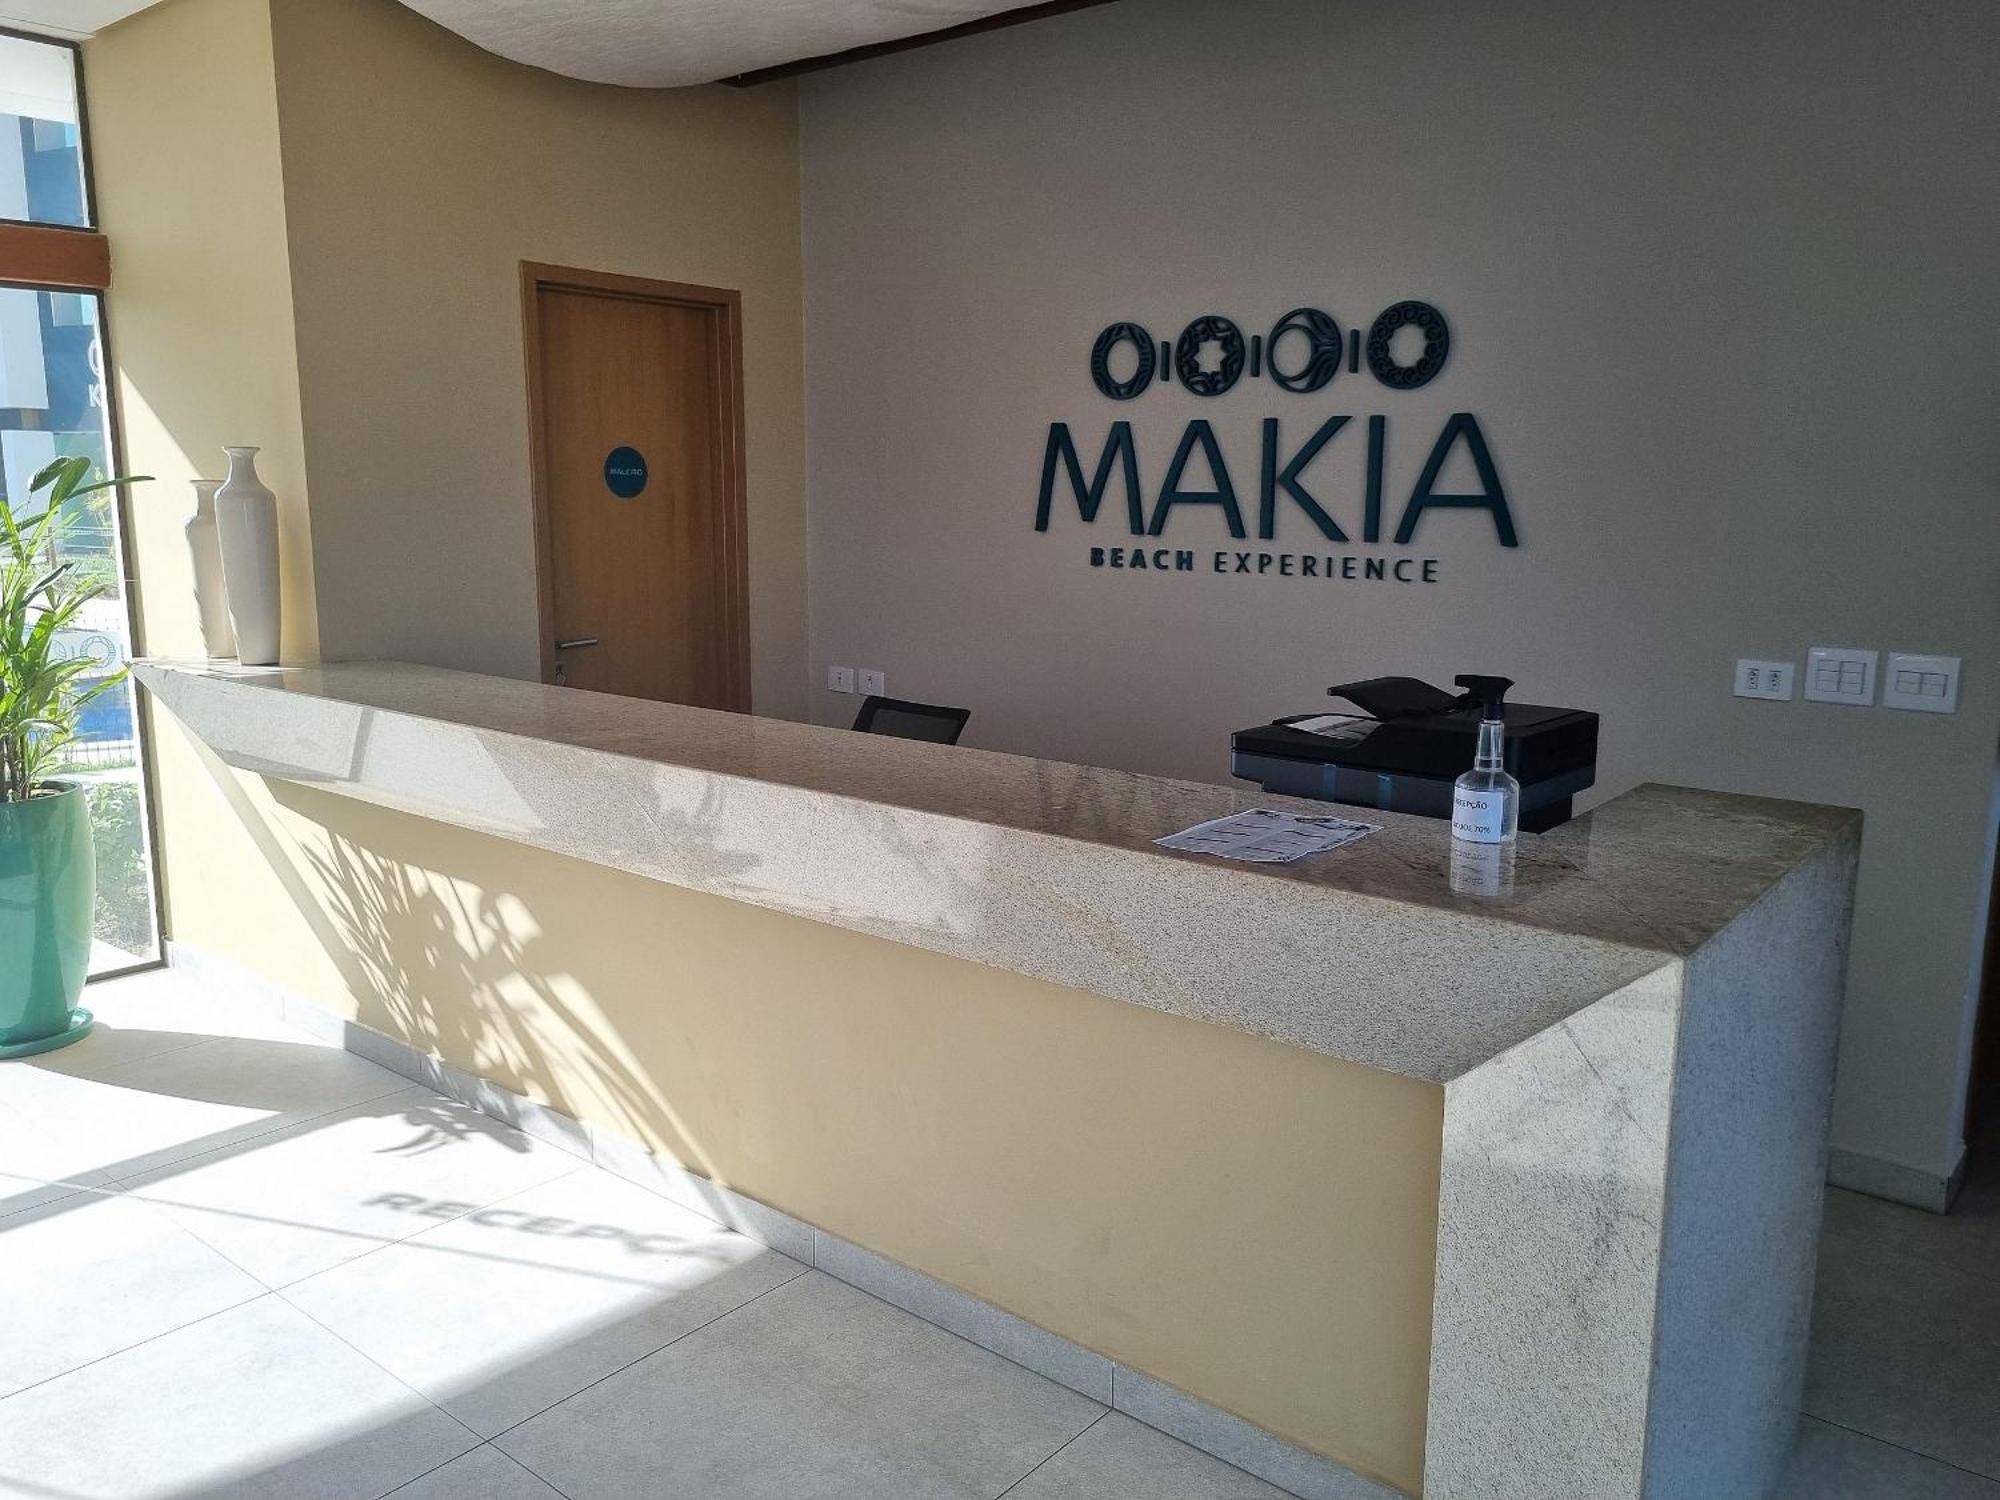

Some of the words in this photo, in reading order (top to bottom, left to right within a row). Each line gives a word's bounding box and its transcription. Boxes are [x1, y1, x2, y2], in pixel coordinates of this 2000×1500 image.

[1035, 412, 1519, 547] MAKIA
[1090, 547, 1194, 571] BEACH
[1213, 551, 1440, 583] EXPERIENCE
